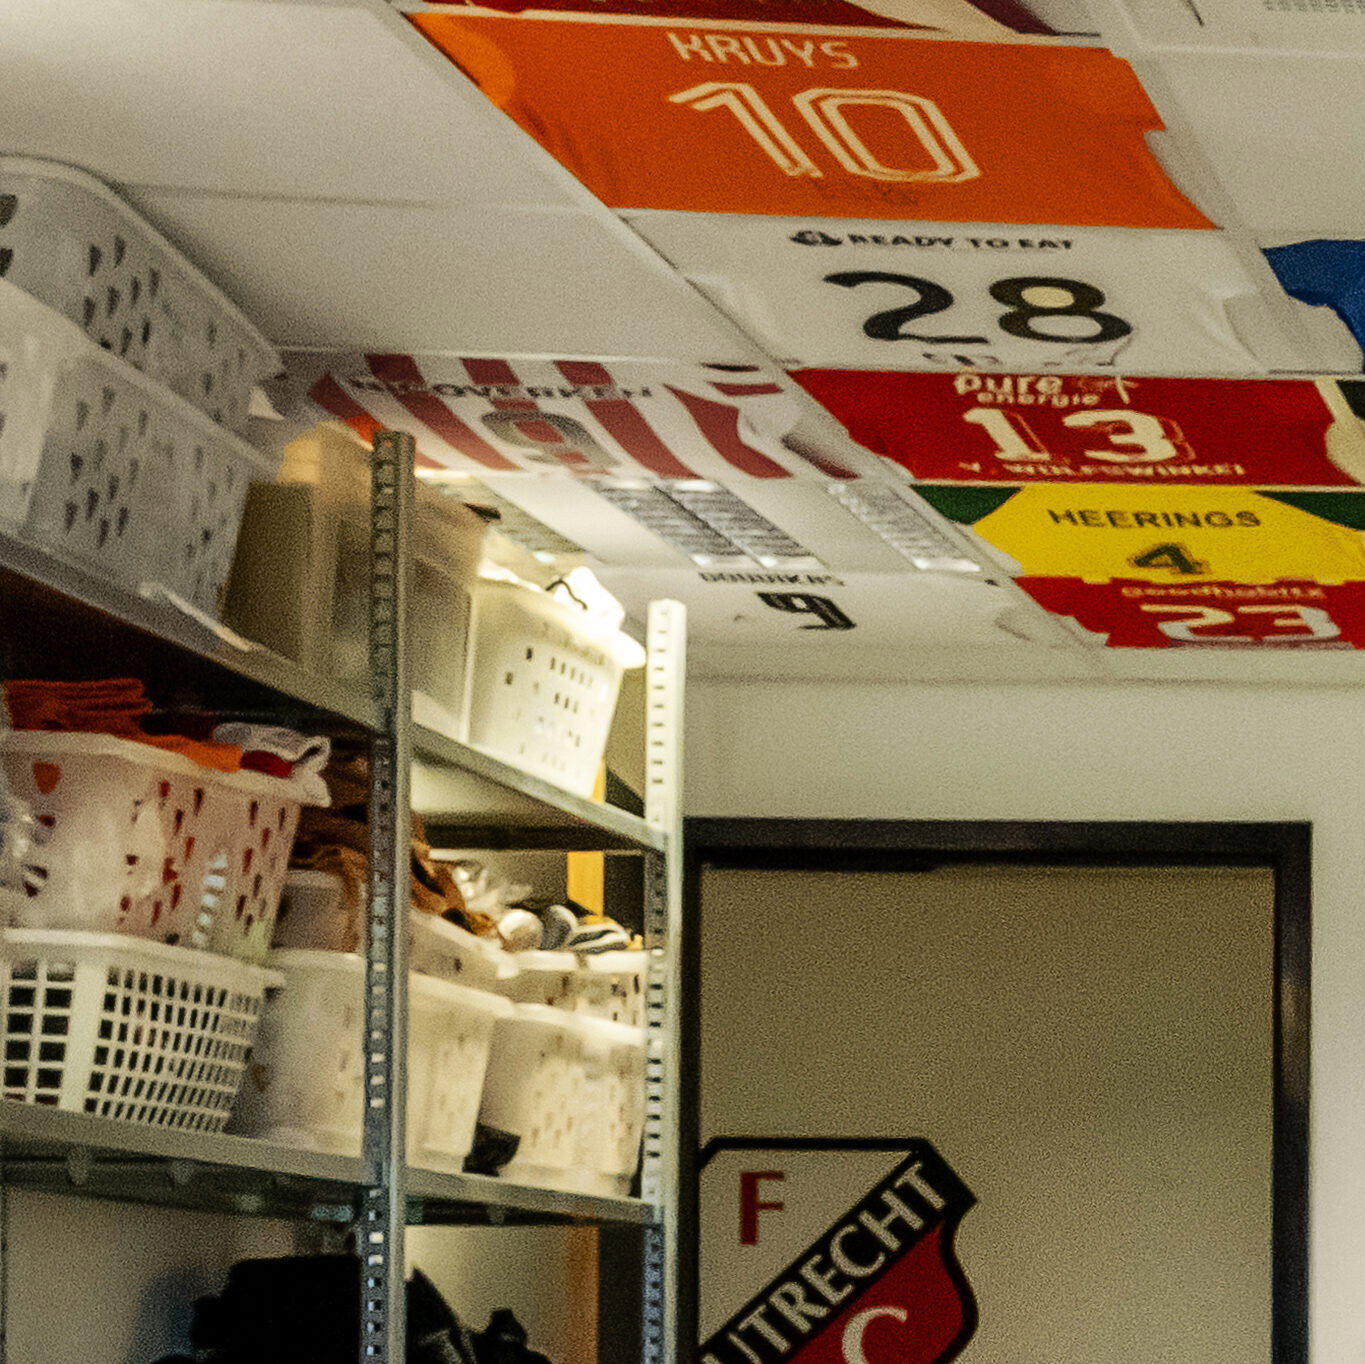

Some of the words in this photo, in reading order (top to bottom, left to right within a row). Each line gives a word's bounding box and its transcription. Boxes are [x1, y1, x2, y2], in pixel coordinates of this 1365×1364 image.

[667, 32, 858, 68] KRUYS
[669, 81, 980, 182] 10
[847, 234, 954, 247] READY
[965, 238, 1010, 249] TO
[1018, 238, 1073, 249] EAT
[822, 271, 1132, 342] 28
[962, 407, 1195, 463] 13
[1047, 508, 1261, 528] HEERINGS
[1126, 542, 1210, 575] 4
[1140, 603, 1343, 641] 23
[740, 1171, 784, 1245] F
